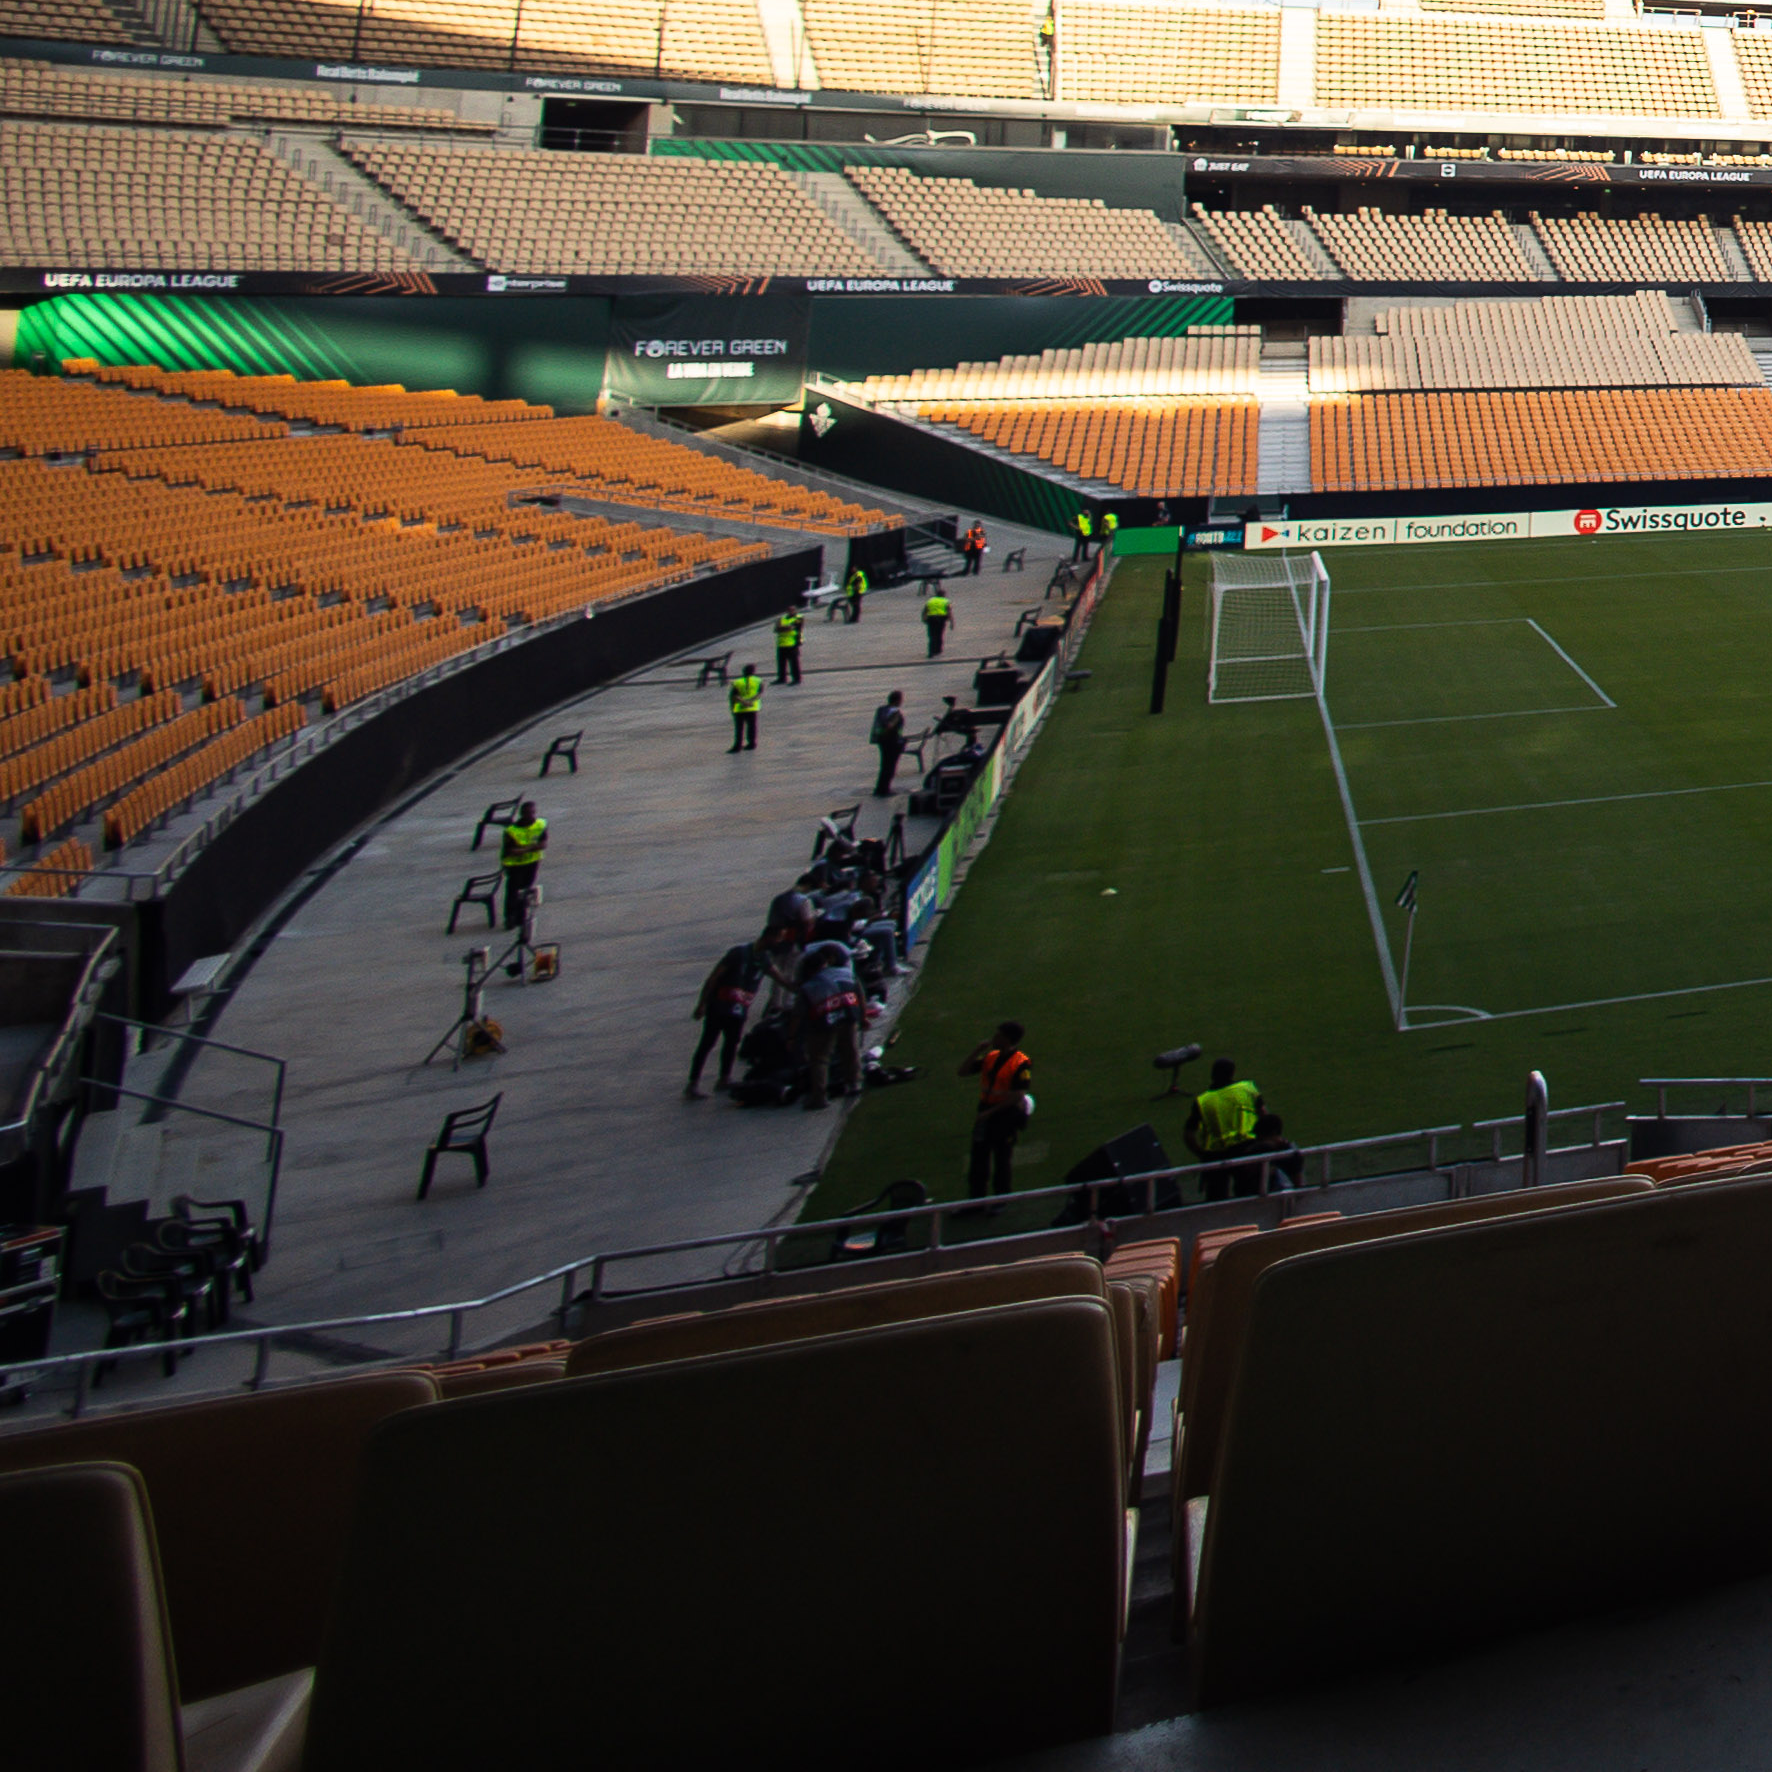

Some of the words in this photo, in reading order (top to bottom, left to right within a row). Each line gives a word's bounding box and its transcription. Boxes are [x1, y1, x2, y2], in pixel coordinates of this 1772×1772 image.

[1639, 170, 1667, 180] UEFA
[1669, 170, 1709, 181] EUROPA
[1711, 171, 1750, 182] LEAGUE
[45, 273, 92, 288] UEFA
[95, 274, 167, 289] EUROPA
[171, 274, 239, 289] LEAGUE
[807, 280, 844, 291] UEFA
[846, 280, 900, 292] EUROPA
[903, 280, 954, 292] LEAGUE
[635, 340, 724, 358] FOREVER
[729, 339, 788, 356] GREEN
[1605, 507, 1746, 531] Swissquote
[1297, 523, 1386, 543] kaizen
[1406, 518, 1518, 539] foundation
